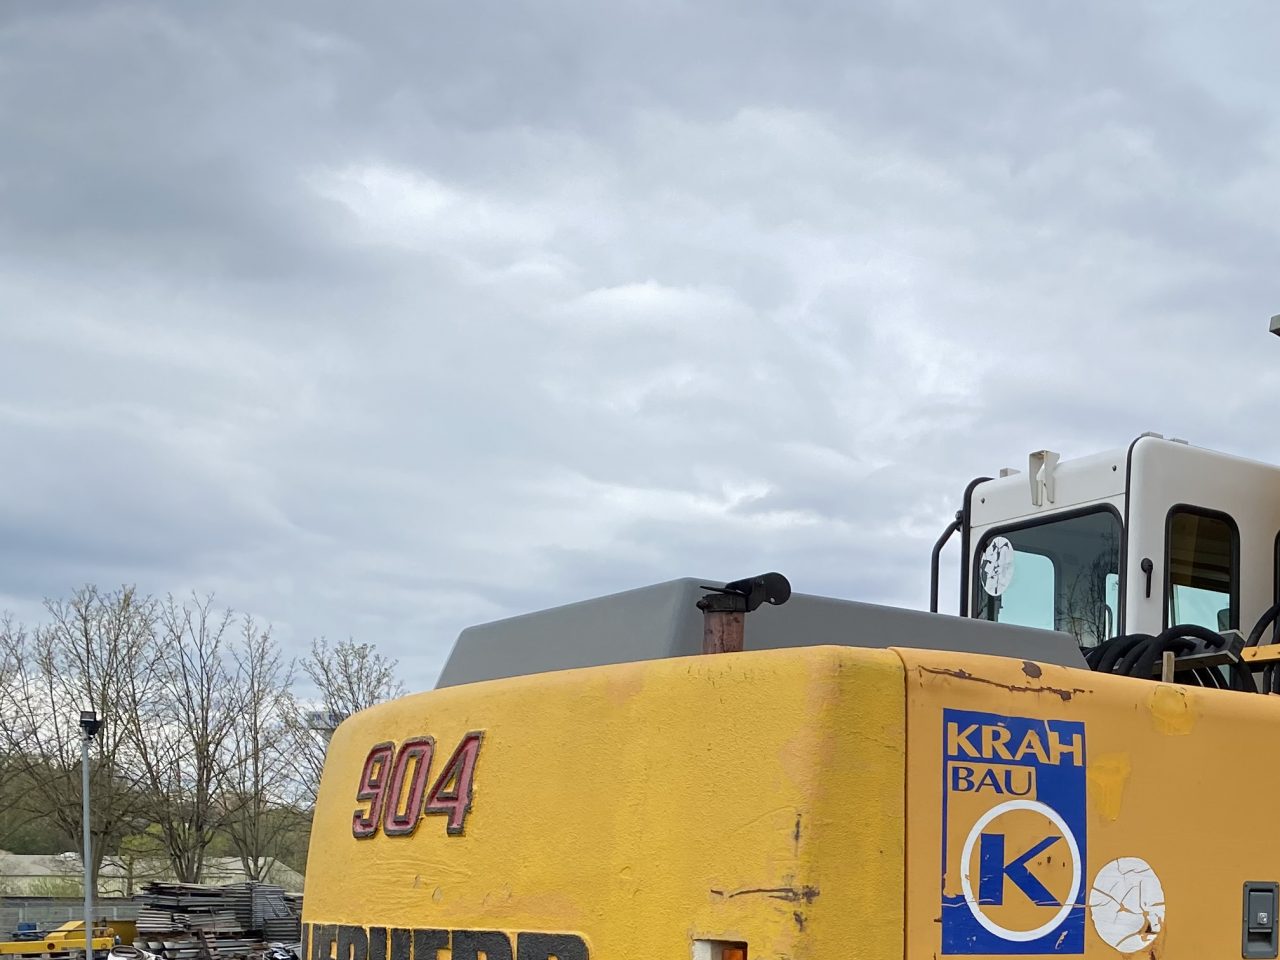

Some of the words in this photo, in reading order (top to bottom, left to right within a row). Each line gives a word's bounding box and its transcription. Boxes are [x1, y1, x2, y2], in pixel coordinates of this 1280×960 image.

[947, 721, 1083, 766] KRAH
[353, 730, 485, 839] 904
[951, 766, 1032, 796] BAU
[979, 833, 1063, 907] K
